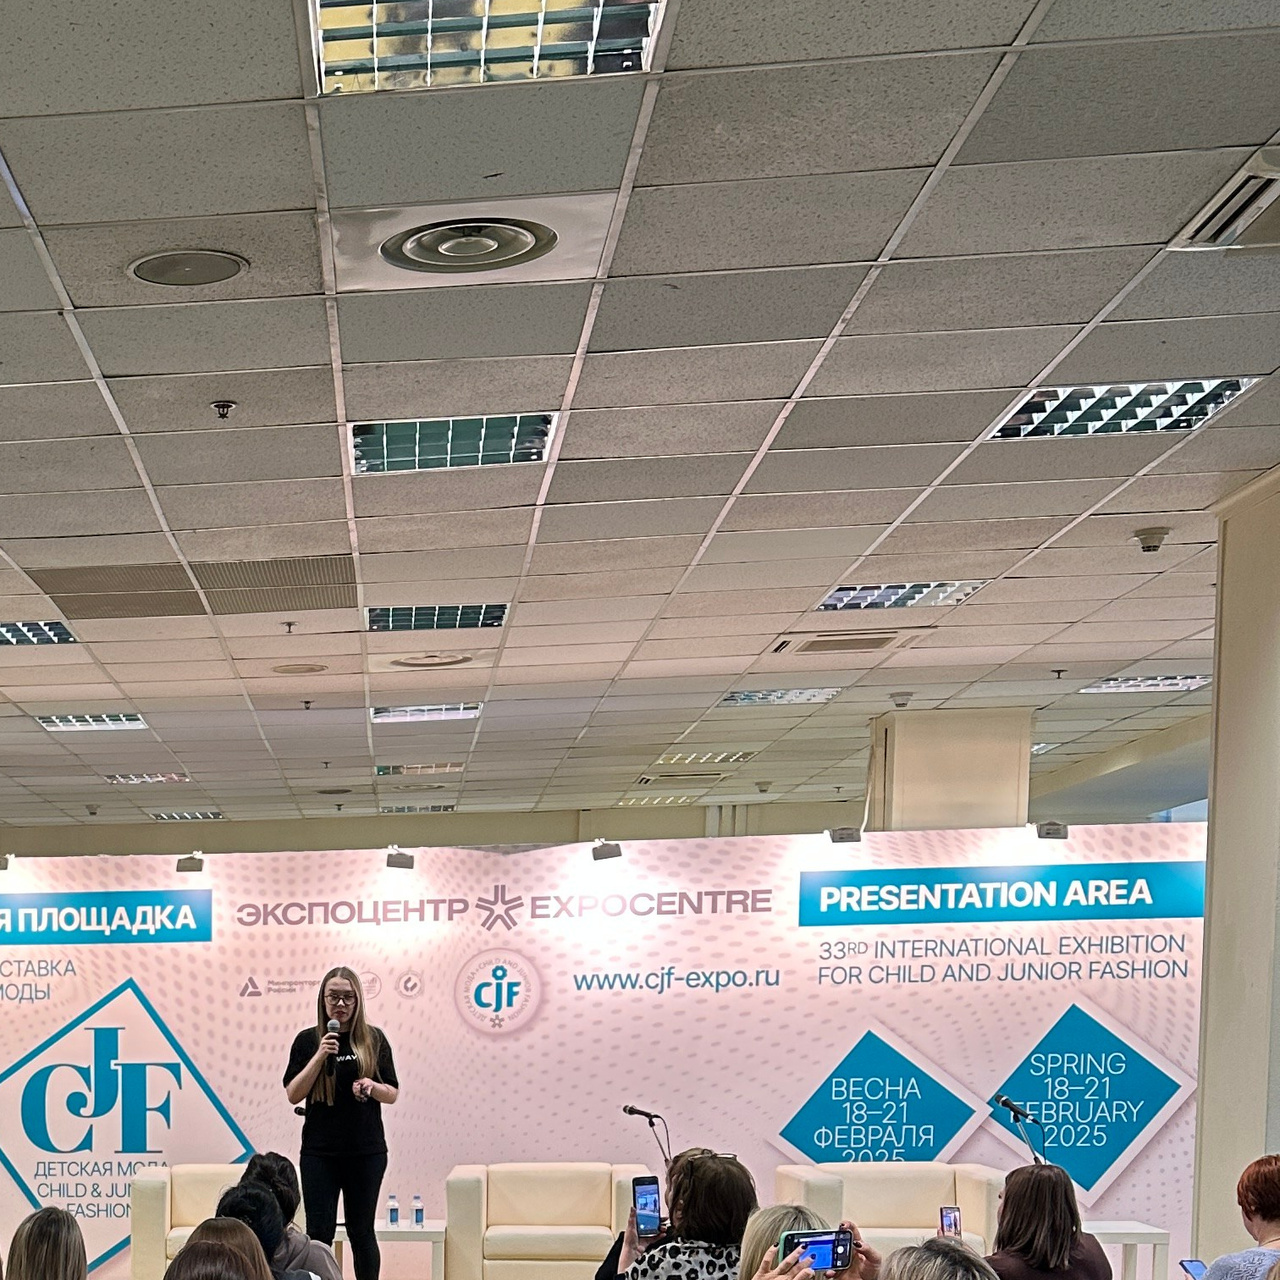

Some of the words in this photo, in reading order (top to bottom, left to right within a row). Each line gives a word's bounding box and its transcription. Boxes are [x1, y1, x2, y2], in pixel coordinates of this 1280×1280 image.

[530, 889, 773, 919] EXPOCENTRE
[820, 880, 1057, 912] PRESENTATION
[1062, 878, 1154, 906] AREA
[18, 904, 197, 936] ПЛОЩАДКА
[236, 898, 469, 927] ЭКСПОЦЕНТР
[818, 941, 869, 960] 33RD
[874, 937, 1052, 959] INTERNATIONAL
[1059, 933, 1186, 955] EXHIBITION
[573, 966, 780, 995] www.cjf-expo.ru
[818, 966, 862, 985] FOR
[868, 964, 936, 984] CHILD
[941, 963, 991, 983] AND
[997, 961, 1082, 982] JUNIOR
[1088, 960, 1189, 980] FASHION
[1029, 1052, 1127, 1076] SPRING
[20, 1027, 183, 1154] CJF
[831, 1077, 922, 1101] ВЕСНА
[813, 1124, 935, 1149] ФЕВРАЛЯ
[1043, 1124, 1108, 1147] 2025
[34, 1161, 113, 1180] ДЕТСКАЯ
[36, 1182, 87, 1198] CHILD
[91, 1182, 102, 1198] &
